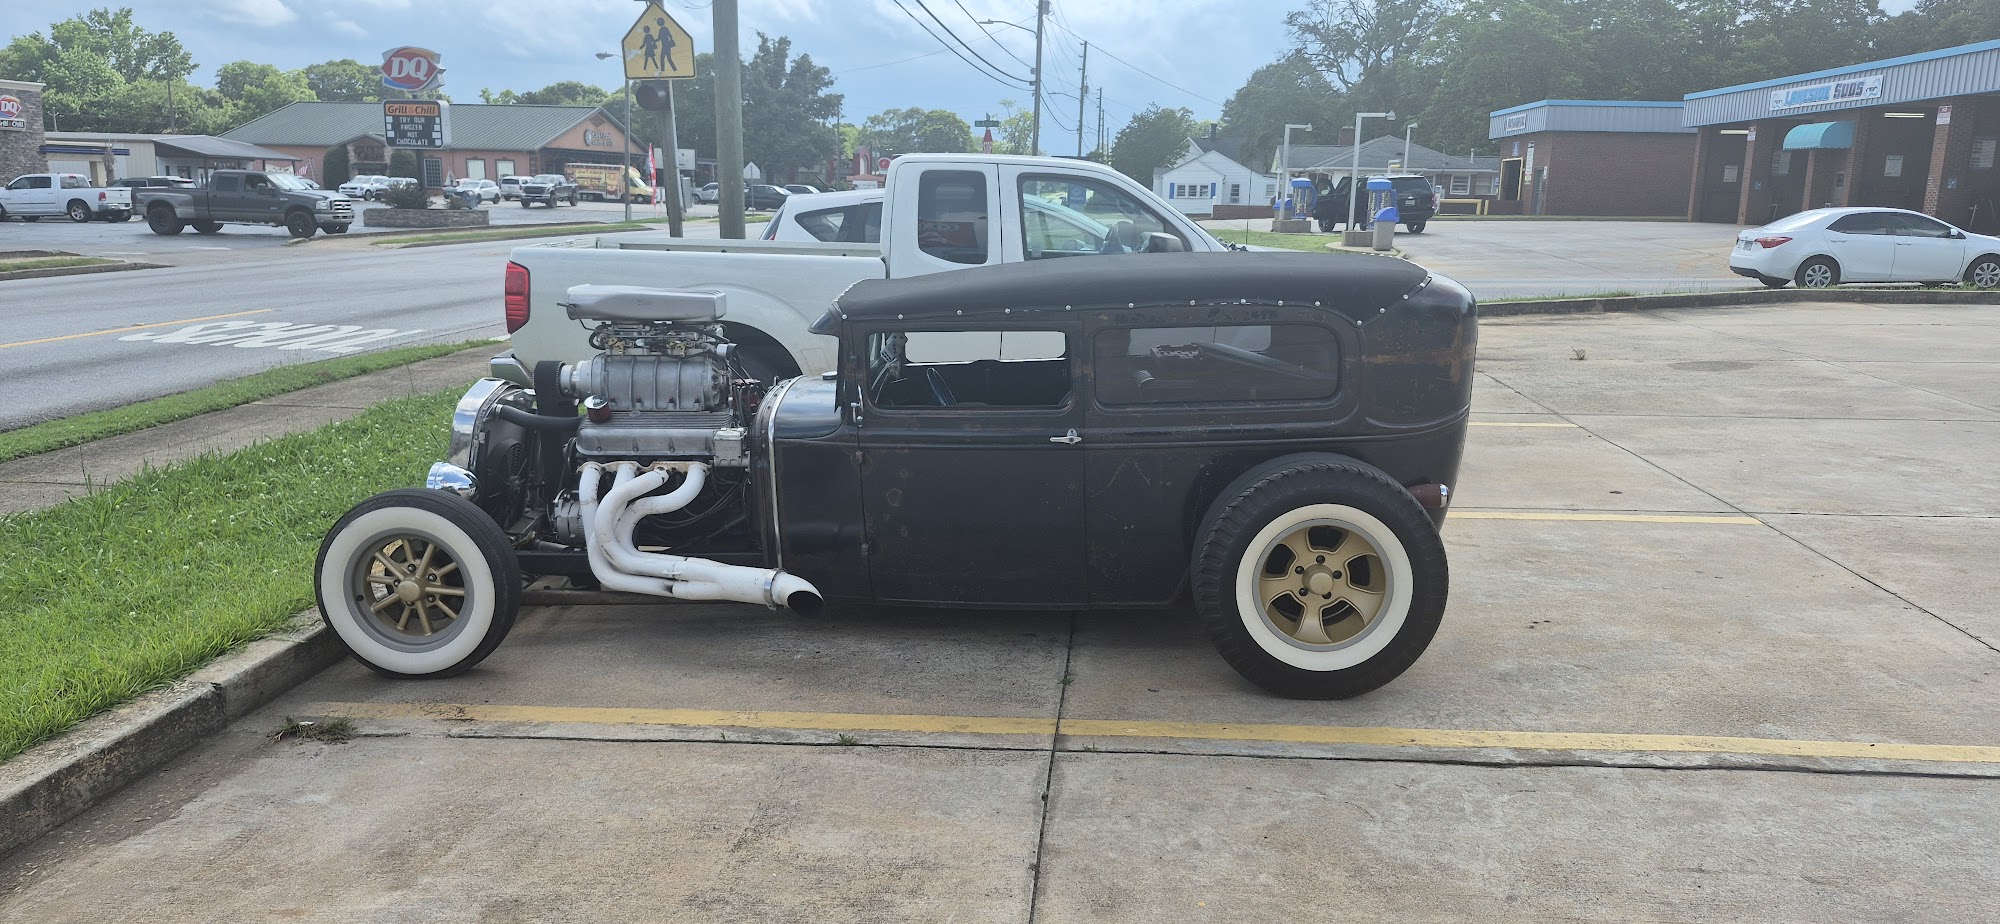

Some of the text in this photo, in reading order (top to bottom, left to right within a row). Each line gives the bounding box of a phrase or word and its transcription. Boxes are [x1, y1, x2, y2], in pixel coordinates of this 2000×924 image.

[390, 57, 428, 80] DQ
[1833, 81, 1865, 99] SUDS
[1, 101, 18, 113] DQ
[387, 105, 407, 114] Grill
[414, 106, 436, 114] Chill
[396, 138, 428, 146] CHOCOLATE
[118, 320, 428, 353] SCHOOL
